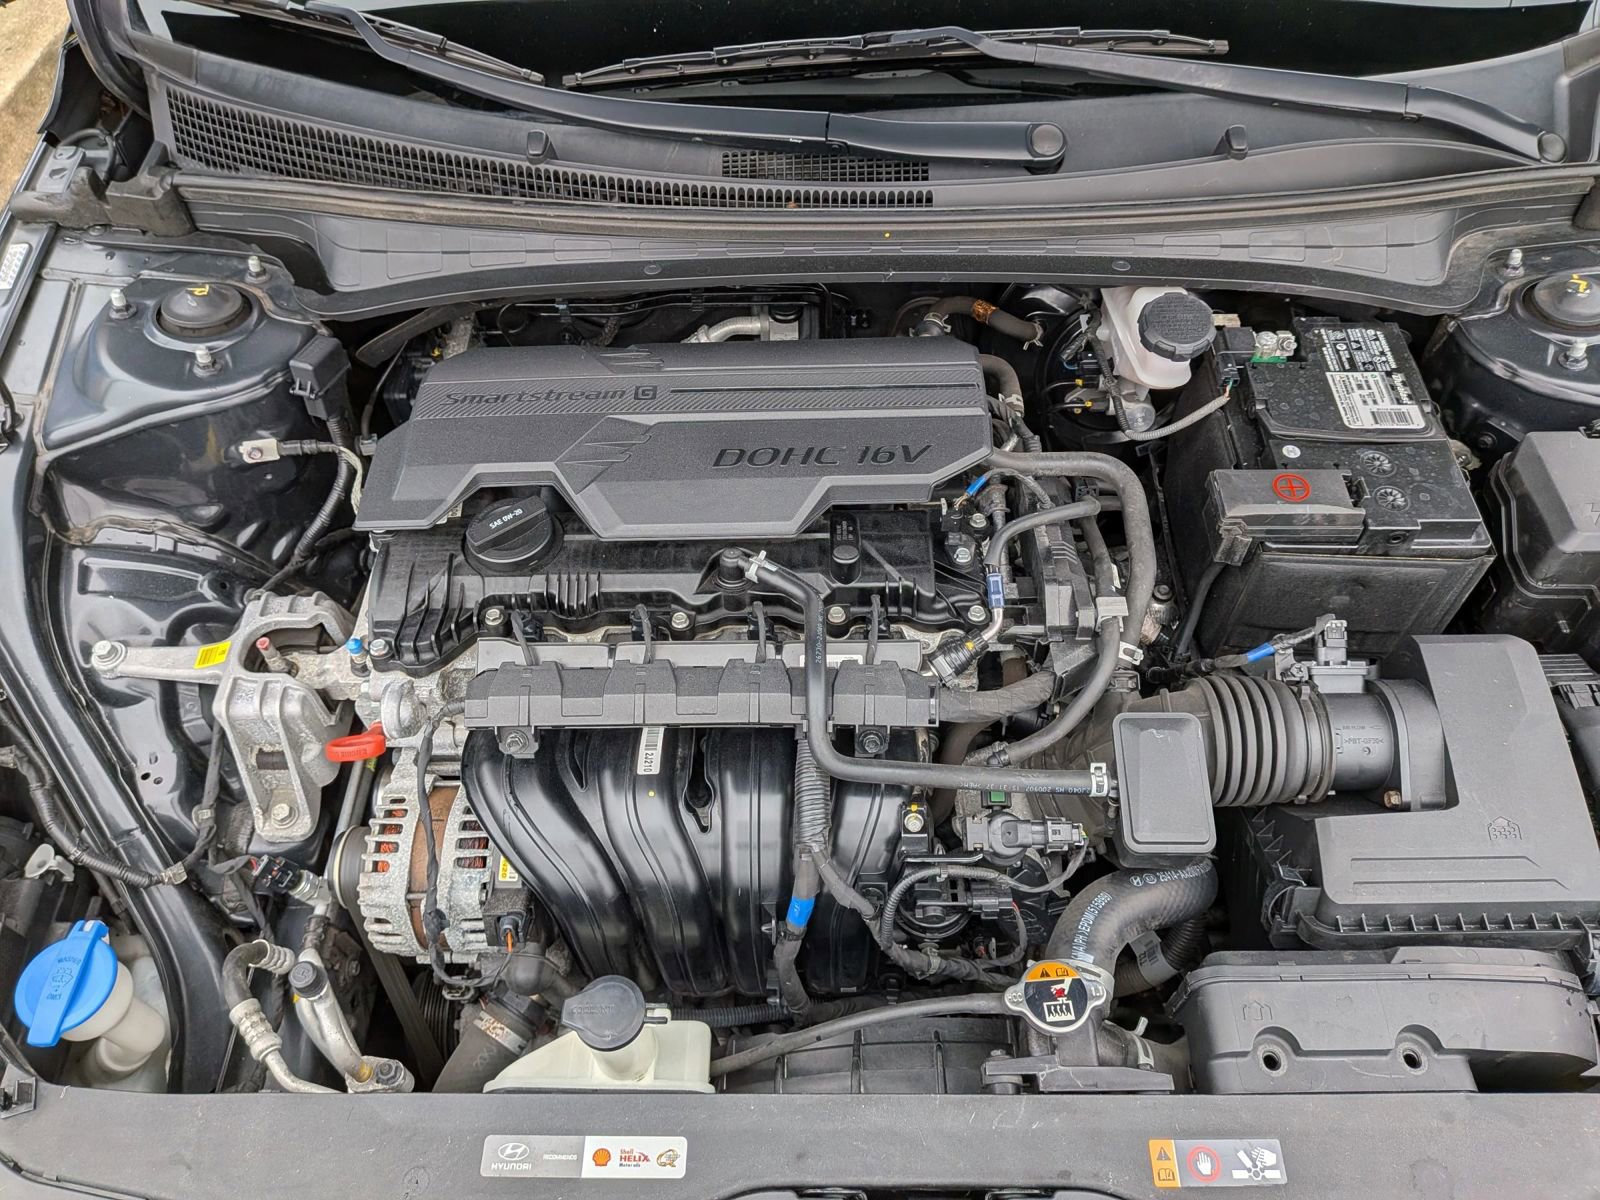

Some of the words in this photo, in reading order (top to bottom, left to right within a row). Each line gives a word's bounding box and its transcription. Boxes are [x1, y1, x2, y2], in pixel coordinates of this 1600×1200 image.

[440, 388, 626, 404] Smartstream
[712, 446, 847, 468] DOHC
[857, 444, 934, 466] 16V
[489, 517, 504, 530] SAE
[502, 508, 524, 522] 0W-20
[643, 752, 655, 773] 2J210
[619, 1148, 634, 1156] Shell
[619, 1154, 651, 1163] HELIX
[491, 1162, 532, 1171] HYUNDAI
